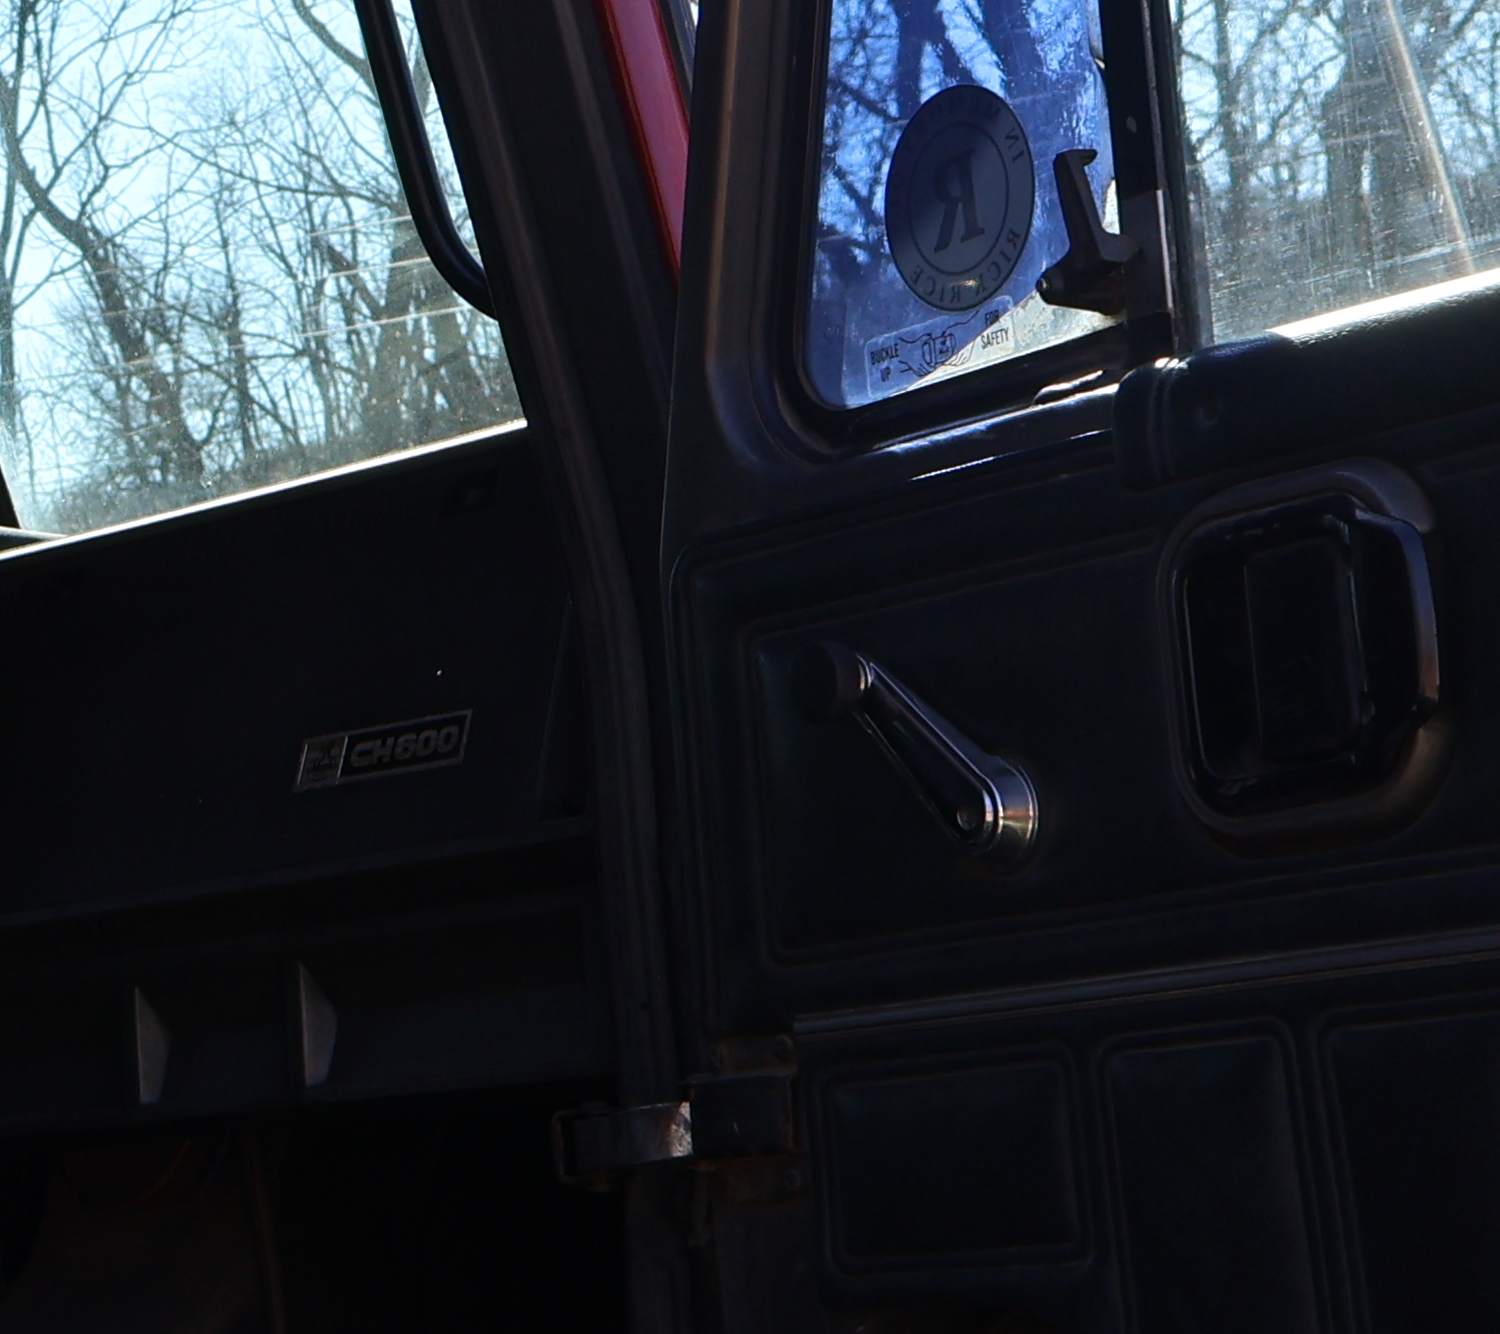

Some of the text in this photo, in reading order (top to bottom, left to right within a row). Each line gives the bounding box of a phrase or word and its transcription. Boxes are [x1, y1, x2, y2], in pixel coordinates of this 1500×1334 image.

[980, 327, 1009, 349] SAFETY
[870, 343, 899, 365] BUCKLE
[350, 724, 460, 768] CH600
